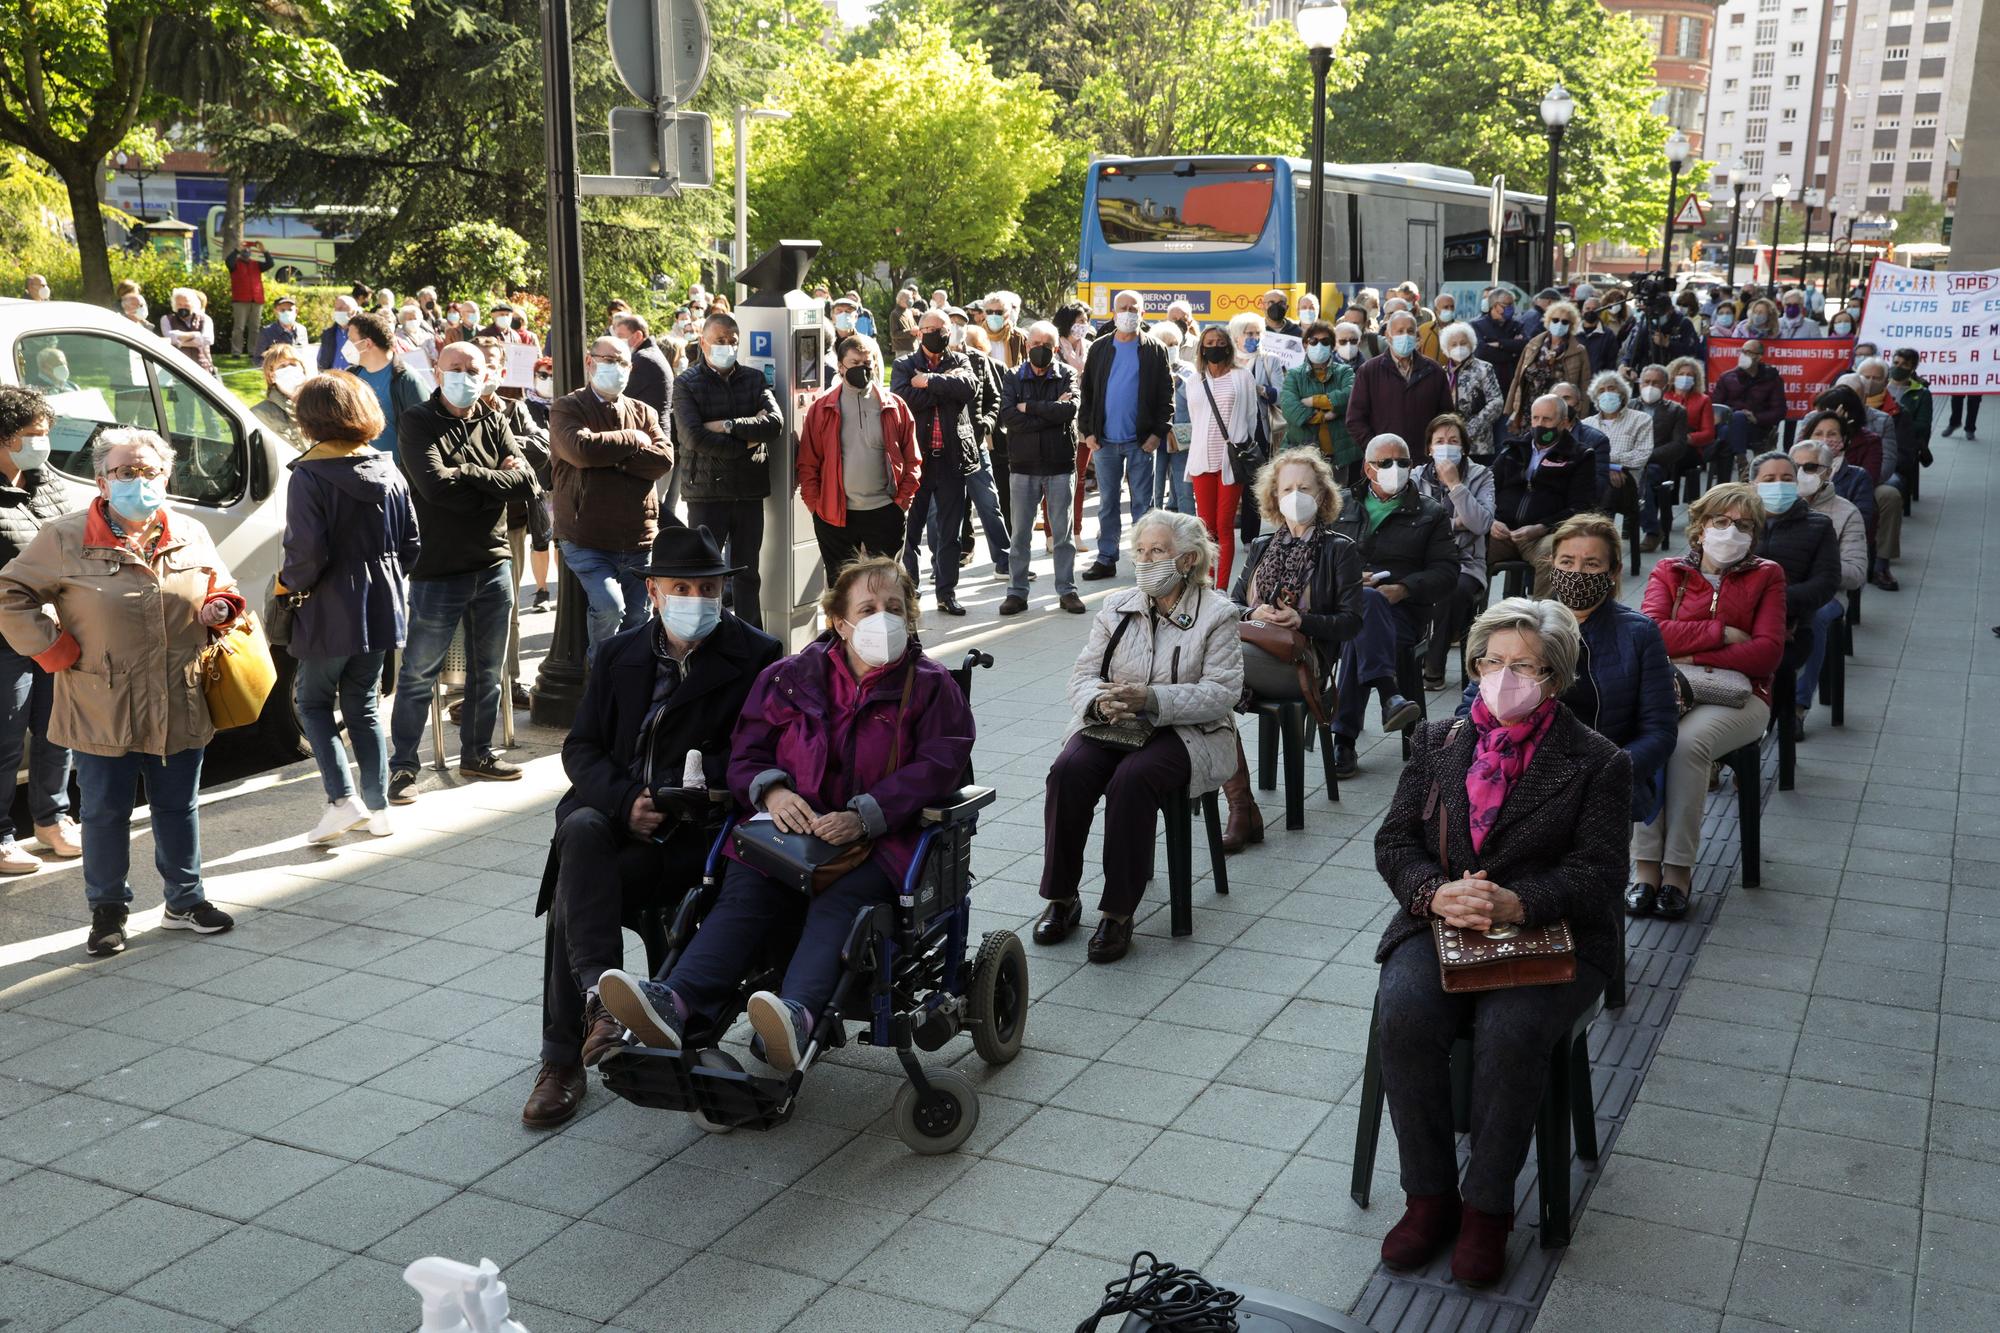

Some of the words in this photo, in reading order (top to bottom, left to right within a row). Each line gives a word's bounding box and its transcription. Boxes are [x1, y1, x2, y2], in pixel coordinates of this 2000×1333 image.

[1955, 277, 1989, 290] APG
[1173, 293, 1187, 301] DEL
[1951, 301, 1971, 313] DE
[1961, 325, 1980, 338] DE
[756, 336, 767, 352] P
[1768, 346, 1835, 359] PENSIONISTAS
[1838, 349, 1851, 359] DE
[1883, 350, 1957, 363] RRTES
[1970, 350, 1979, 362] A
[1784, 383, 1801, 393] LOS
